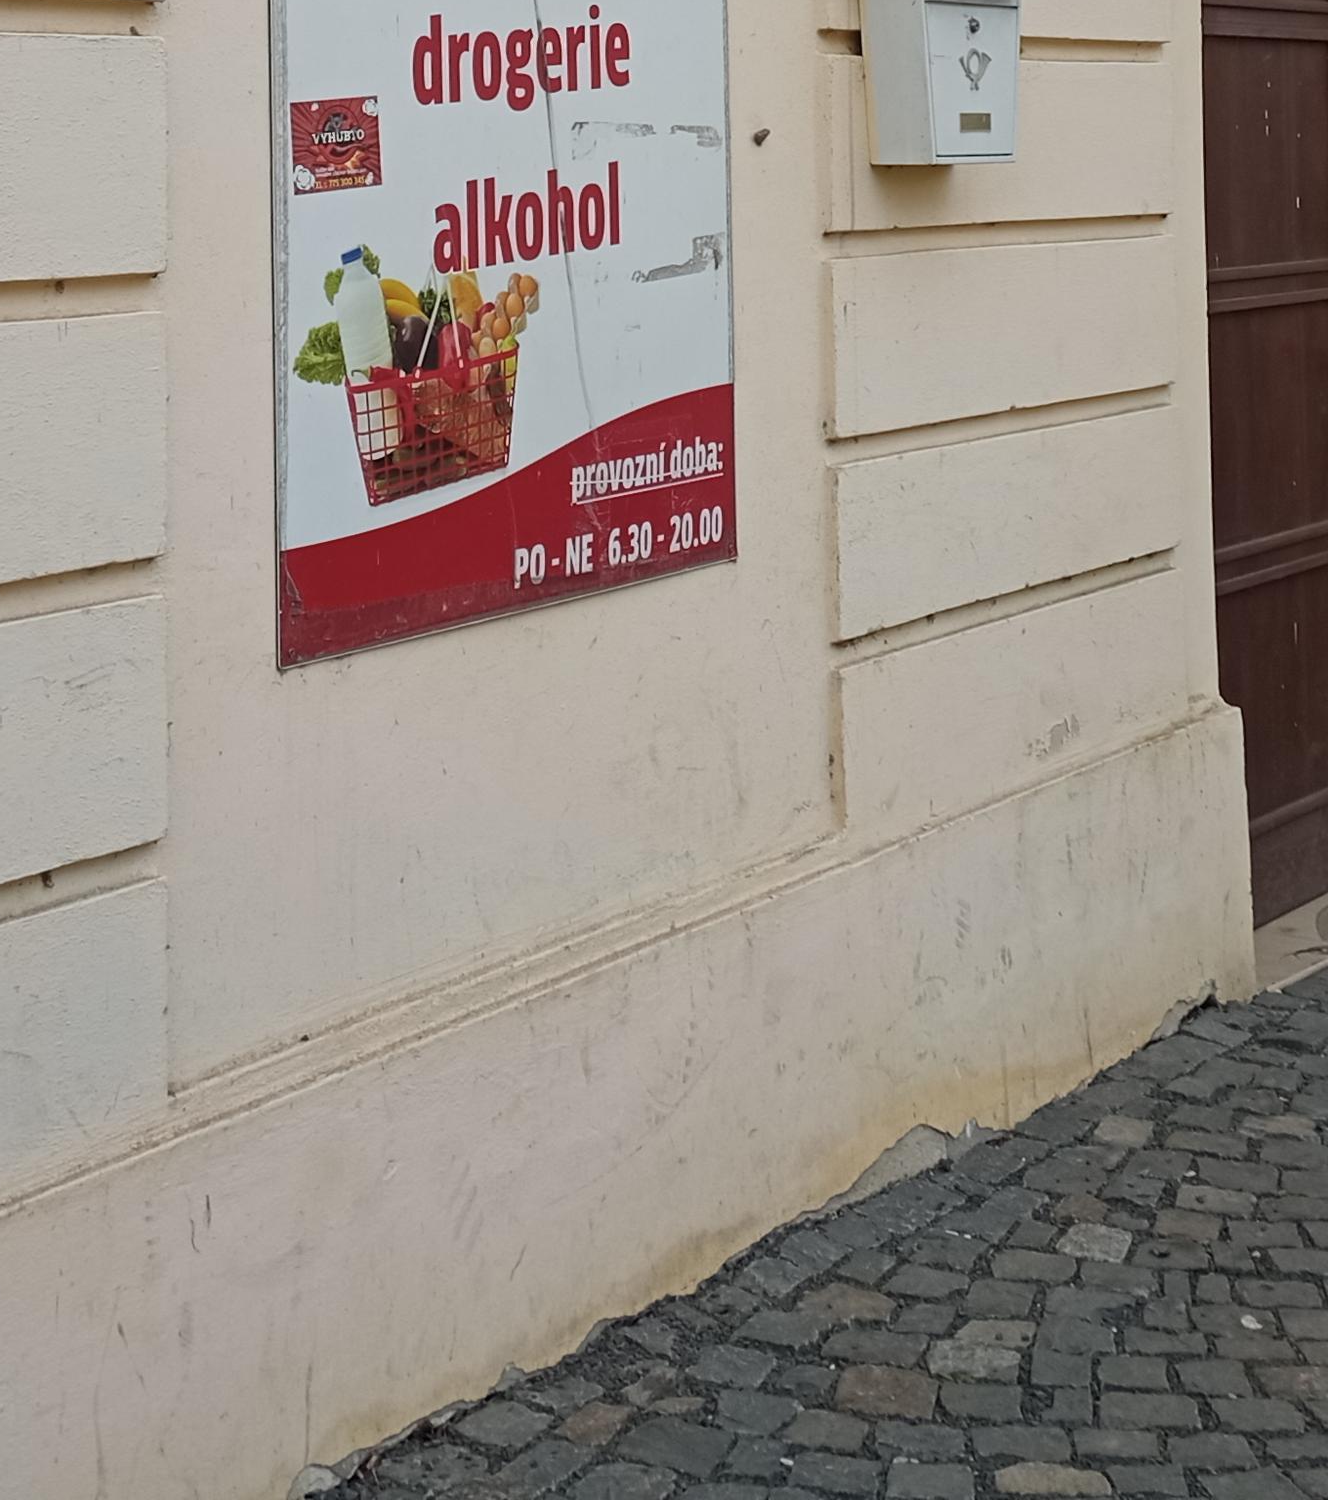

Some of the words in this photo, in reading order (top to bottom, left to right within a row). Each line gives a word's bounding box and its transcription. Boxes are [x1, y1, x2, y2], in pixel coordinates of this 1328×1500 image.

[412, 5, 631, 111] drogerie
[433, 161, 621, 274] alkohol
[570, 442, 665, 504] provozní
[669, 436, 724, 480] doba:
[513, 543, 546, 590] PO
[565, 533, 594, 577] NE
[607, 520, 653, 566] 6.30
[668, 505, 723, 555] 20.00
